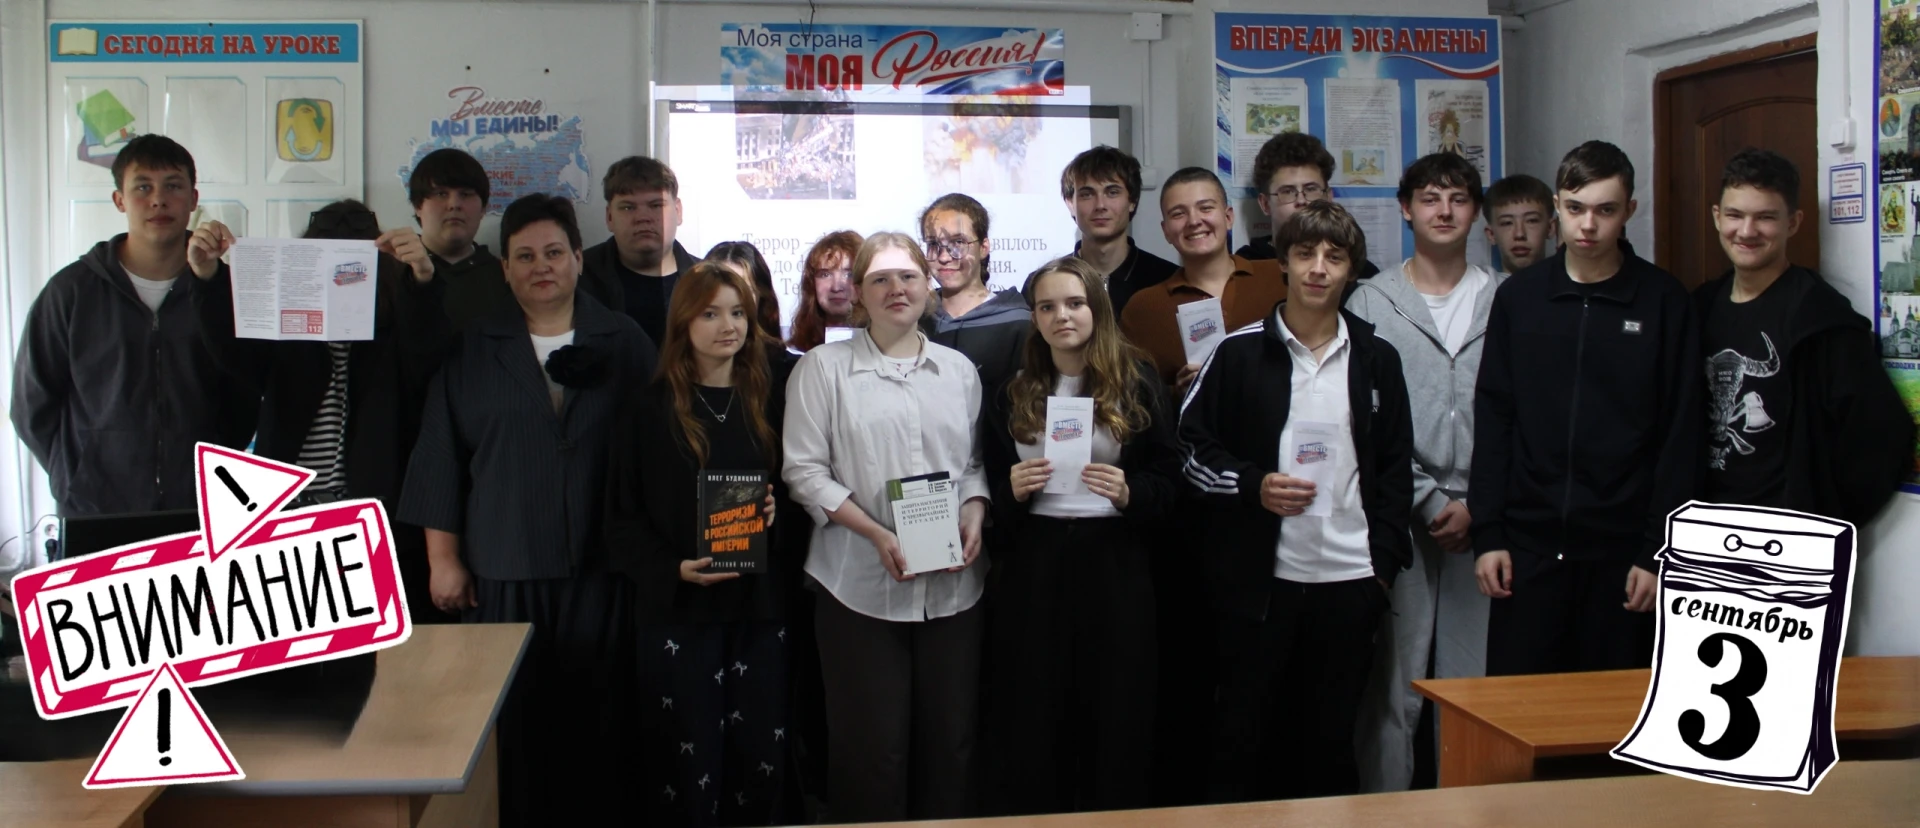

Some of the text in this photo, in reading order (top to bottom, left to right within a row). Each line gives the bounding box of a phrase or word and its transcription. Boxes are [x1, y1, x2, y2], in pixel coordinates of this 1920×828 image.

[103, 34, 341, 57] СЕГОДНЯ НА УРОКЕ
[737, 28, 781, 47] Моя
[789, 34, 863, 52] страна
[1230, 25, 1488, 55] ВПЕРЕДИ ЭКЗАМЕНЫ
[785, 29, 1046, 91] МОЯ Россия!
[448, 86, 543, 121] Вместе
[431, 115, 559, 137] МЫ ЕДИНЫ!
[742, 233, 1047, 255] Террор вплоть
[774, 260, 792, 274] до
[308, 325, 322, 333] 112
[725, 474, 762, 483] БУДНИЦКИЙ
[709, 503, 756, 526] ТЕРРОРИЗМ
[907, 503, 949, 514] ТЕРРИТОРИЙ
[907, 509, 949, 519] ЧРЕЗВЫЧАЙНЫХ
[705, 516, 764, 540] В РОССИЙСКОЙ
[903, 514, 950, 526] СИТУАЦИЯХ
[711, 537, 749, 552] ИМПЕРИИ
